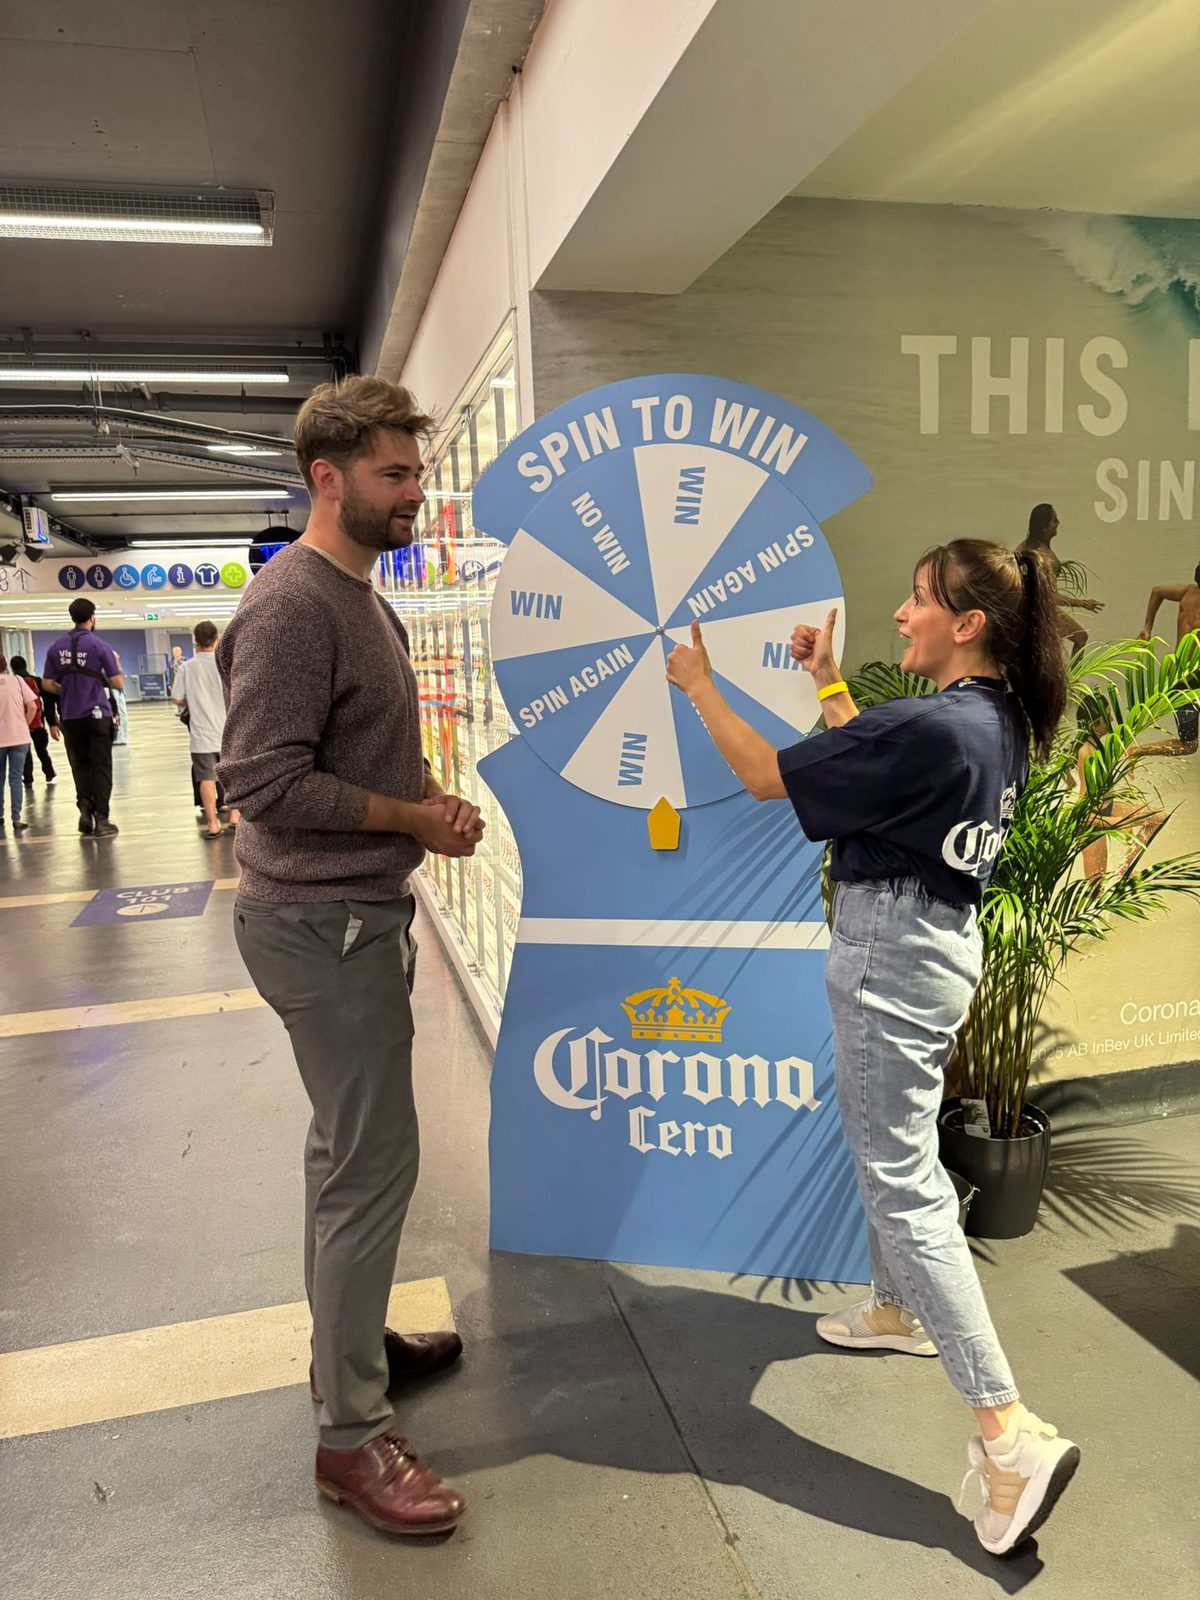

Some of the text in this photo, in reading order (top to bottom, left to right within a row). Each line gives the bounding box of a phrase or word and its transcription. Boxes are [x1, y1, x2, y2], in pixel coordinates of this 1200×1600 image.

[901, 335, 1129, 437] THIS
[518, 395, 809, 493] SPIN TO WIN
[674, 466, 706, 525] WIN
[571, 491, 631, 576] NO WIN
[687, 525, 815, 618] SPIN AGAIN
[510, 590, 563, 620] WIN
[762, 641, 809, 672] IN
[518, 643, 634, 728] SPIN AGAIN
[617, 732, 648, 787] WIN
[116, 887, 190, 898] CLUB
[127, 894, 173, 904] 101
[1120, 1000, 1200, 1025] Corona
[533, 1026, 823, 1121] Corona
[1067, 1043, 1088, 1058] AB
[1093, 1039, 1130, 1054] InBev
[1134, 1033, 1155, 1048] UK
